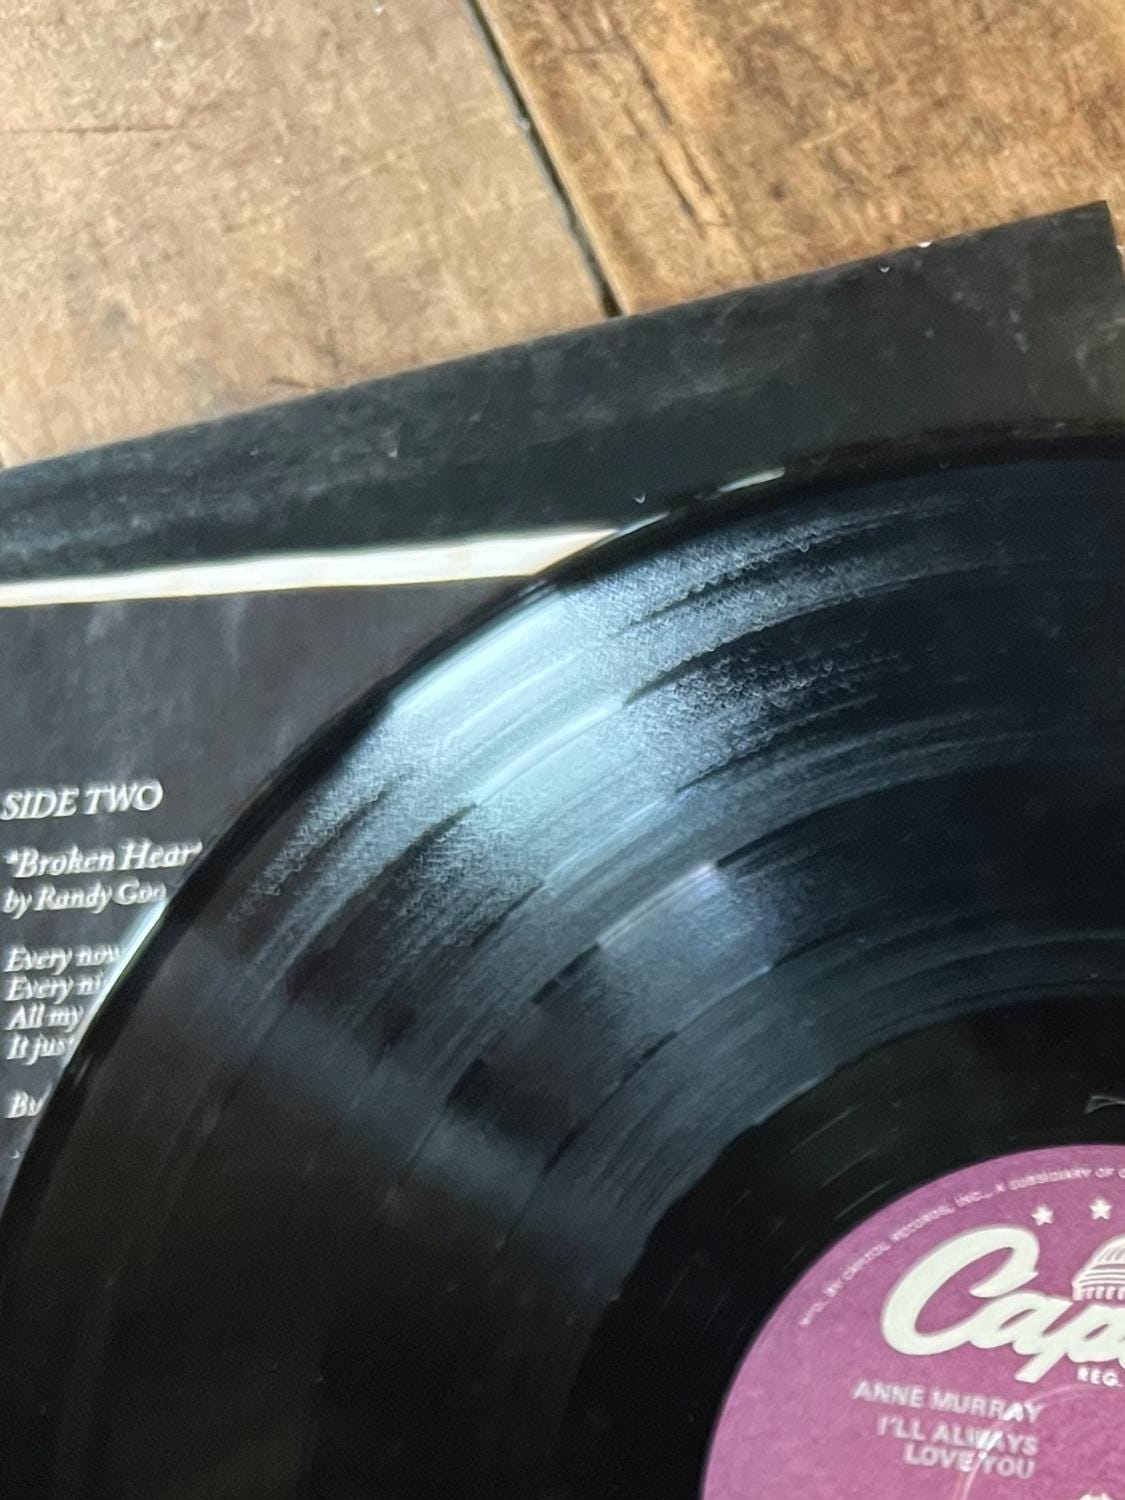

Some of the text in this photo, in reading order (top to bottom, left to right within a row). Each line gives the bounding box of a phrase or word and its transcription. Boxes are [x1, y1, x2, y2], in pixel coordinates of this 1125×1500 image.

[0, 779, 163, 820] SIDE TWO
[118, 838, 203, 870] Hear
[1, 886, 32, 920] by
[35, 880, 113, 914] Randy
[3, 944, 73, 975] Every
[3, 974, 73, 1005] Every
[4, 1002, 84, 1034] All my
[7, 1032, 75, 1065] It jus
[1095, 1167, 1115, 1179] OF
[1077, 1365, 1122, 1387] REG.
[853, 1380, 1041, 1423] ANNE MURRAY
[877, 1415, 1039, 1456] I'LL ALWAYS
[904, 1443, 1035, 1479] LOVE YOU
